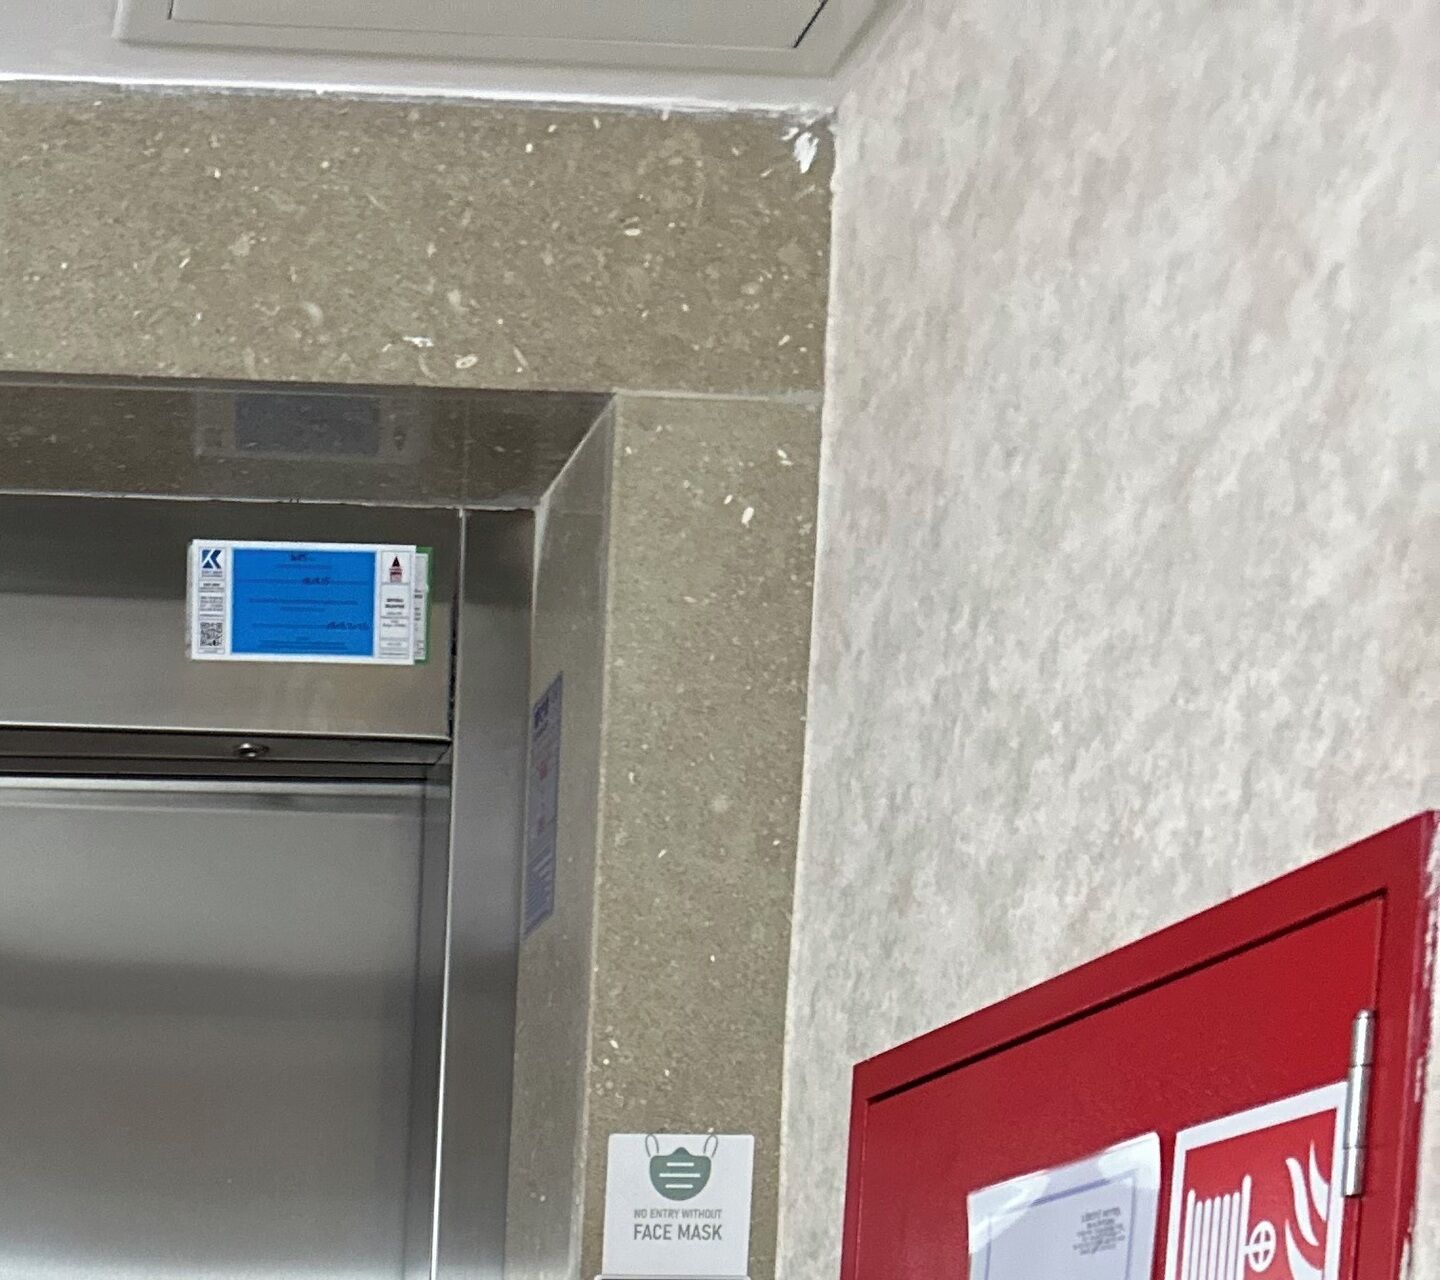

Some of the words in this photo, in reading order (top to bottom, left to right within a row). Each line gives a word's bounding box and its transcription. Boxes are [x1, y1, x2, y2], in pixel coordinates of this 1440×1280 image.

[633, 1209, 647, 1219] NO
[650, 1209, 680, 1219] ENTRY
[681, 1209, 723, 1219] WITHOUT
[633, 1224, 672, 1241] FACE
[677, 1224, 723, 1241] MASK
